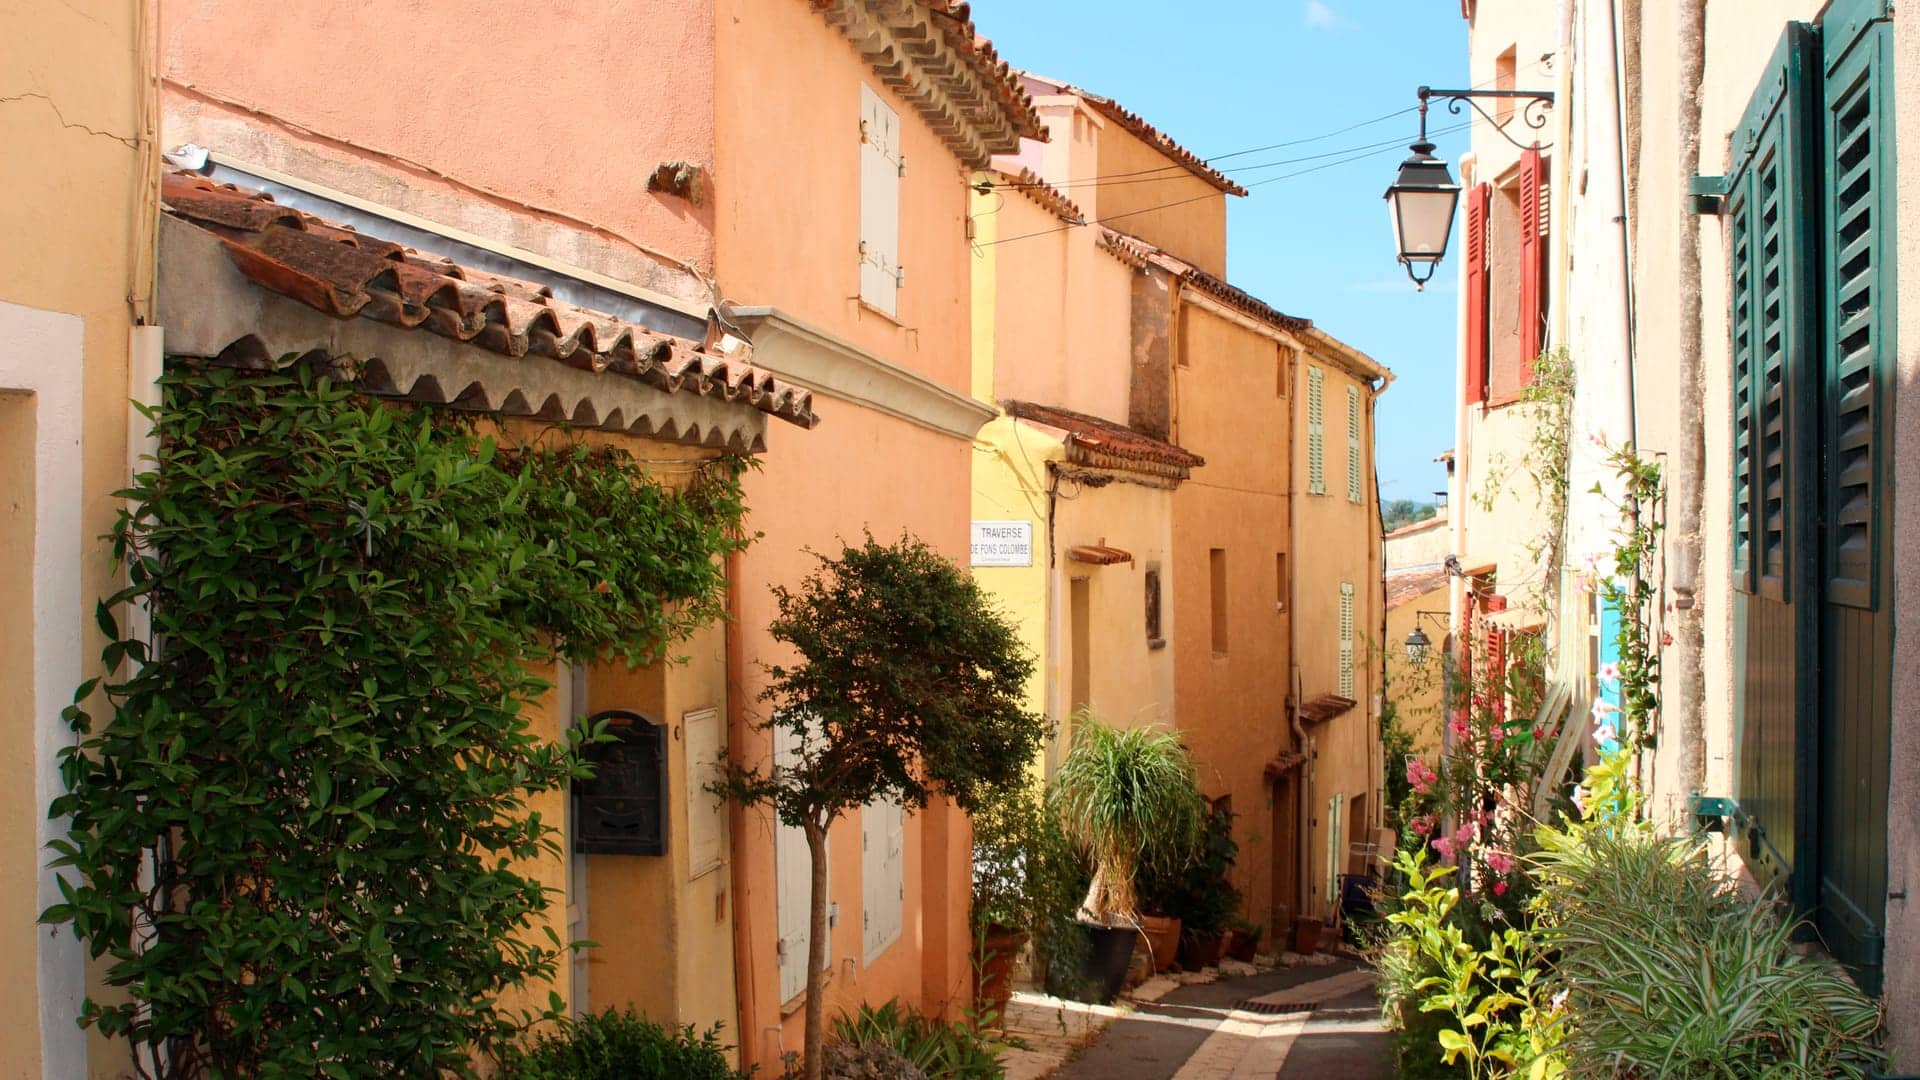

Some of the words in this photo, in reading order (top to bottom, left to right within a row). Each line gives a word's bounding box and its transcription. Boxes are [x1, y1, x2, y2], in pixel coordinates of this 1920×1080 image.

[981, 527, 1022, 538] TRAVERSE
[980, 544, 998, 554] FONS
[999, 544, 1028, 555] COLOMBE
